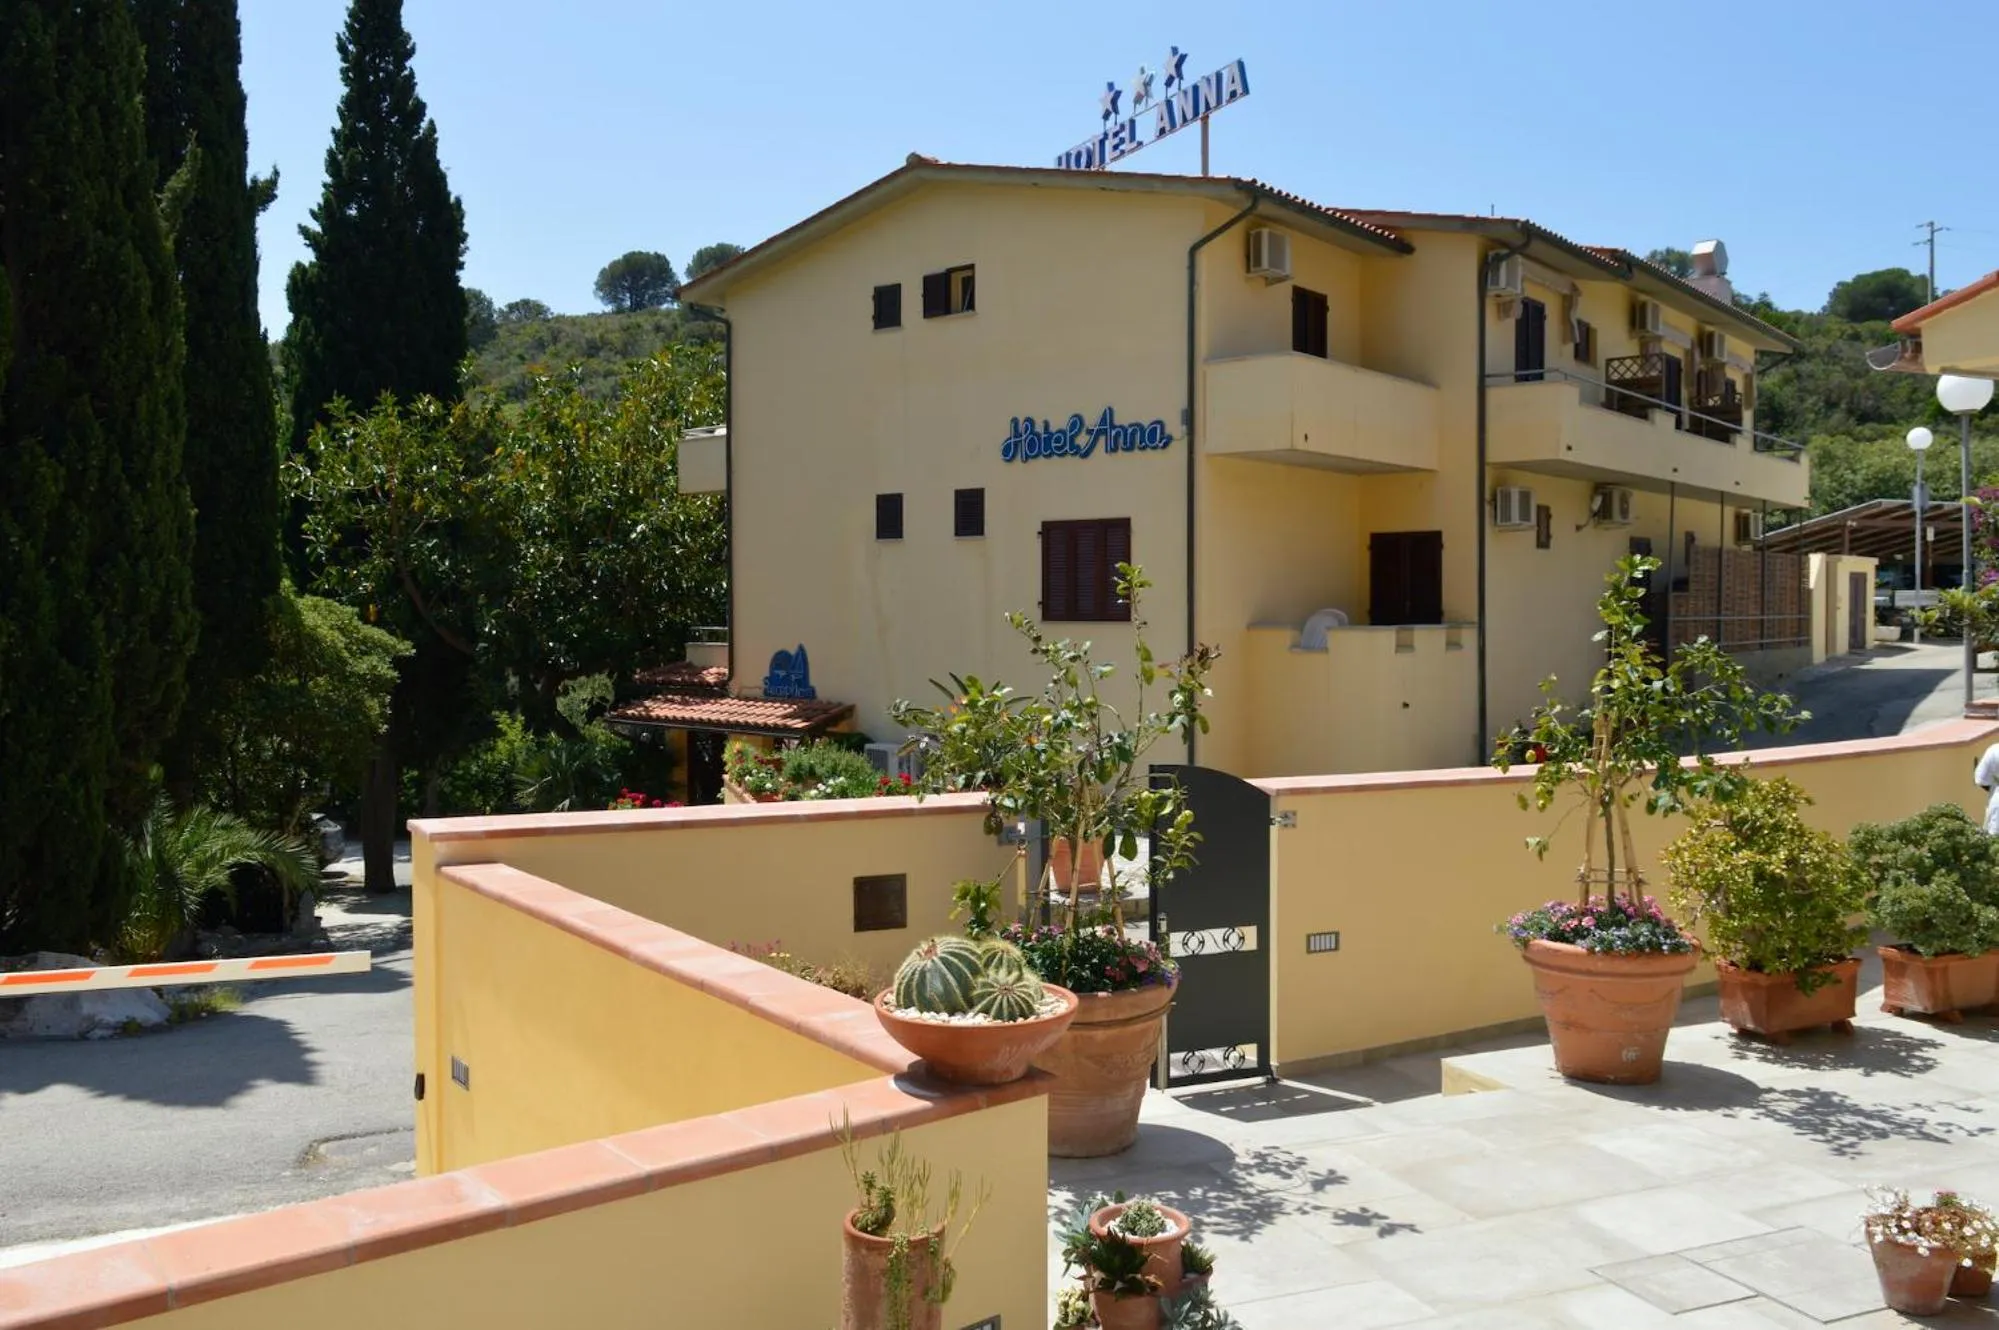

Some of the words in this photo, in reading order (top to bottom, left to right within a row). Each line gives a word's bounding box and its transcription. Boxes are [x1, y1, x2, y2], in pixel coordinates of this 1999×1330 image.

[1155, 58, 1250, 137] ANNA
[1000, 414, 1084, 463] Hotel
[1079, 406, 1173, 459] Anna
